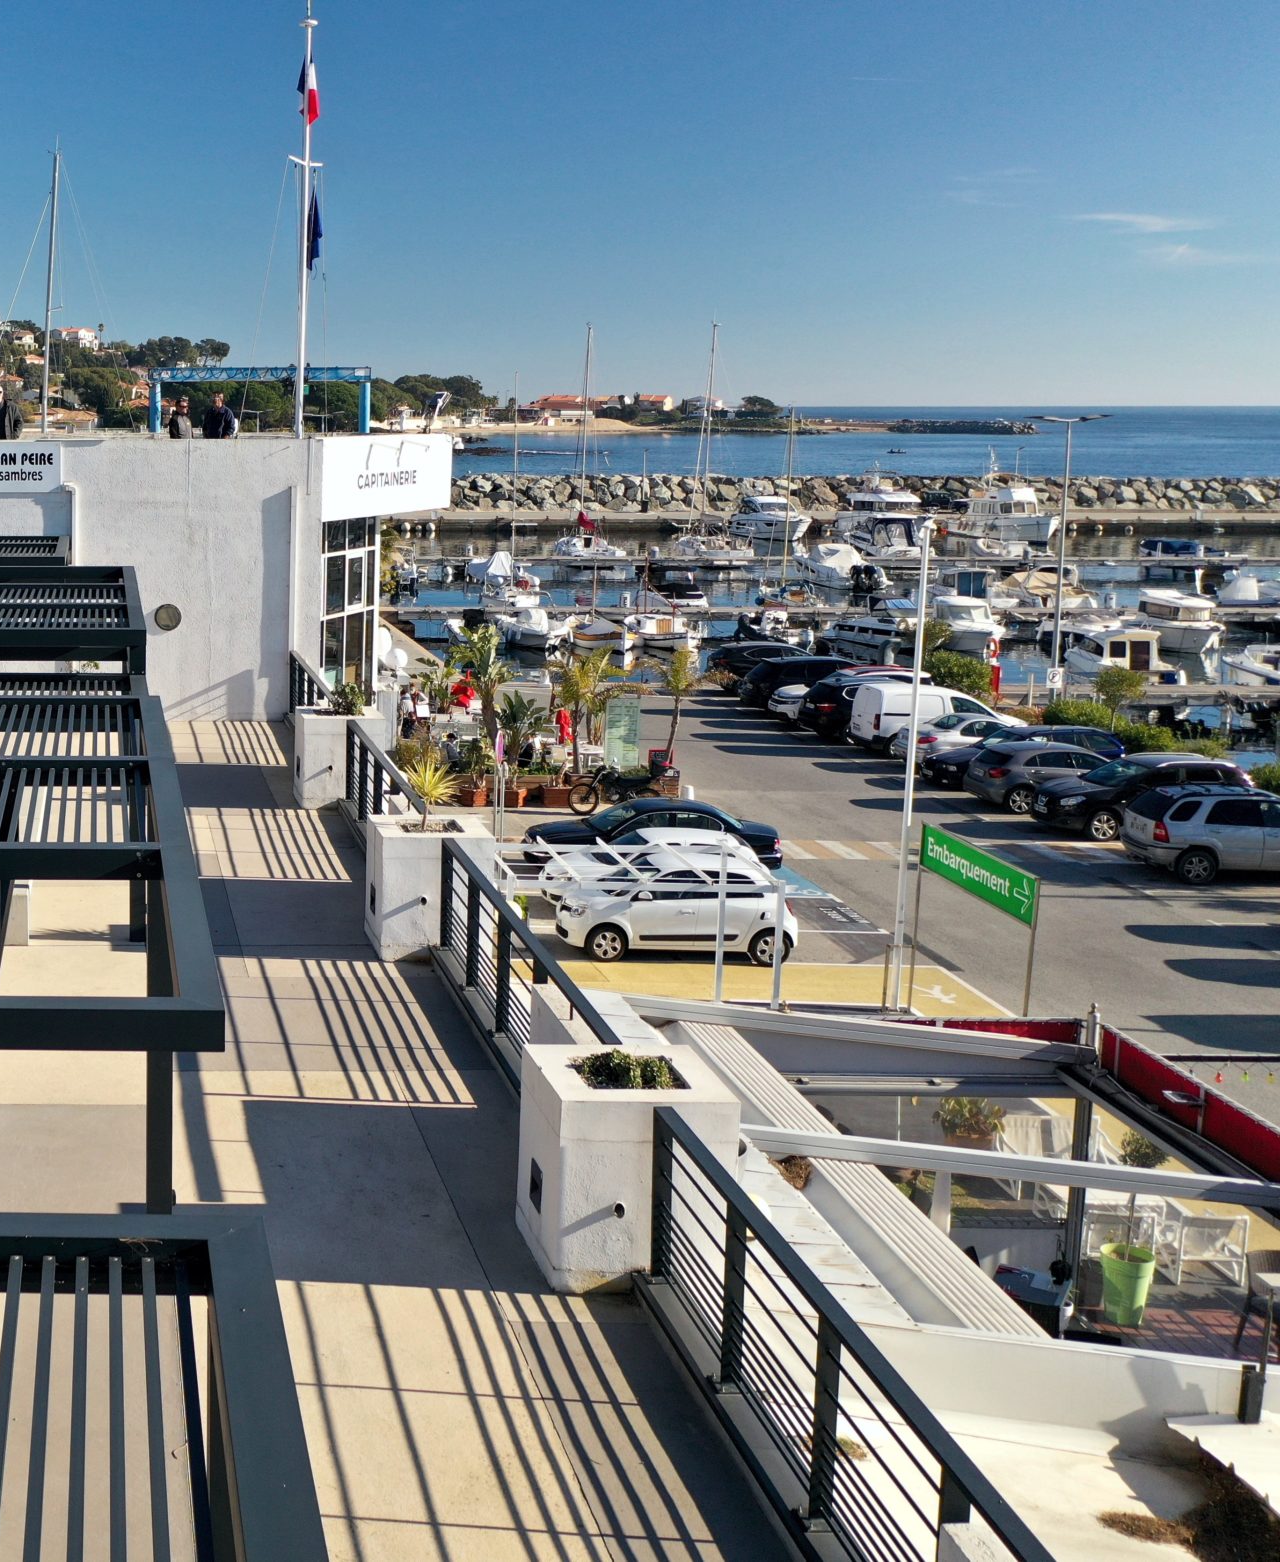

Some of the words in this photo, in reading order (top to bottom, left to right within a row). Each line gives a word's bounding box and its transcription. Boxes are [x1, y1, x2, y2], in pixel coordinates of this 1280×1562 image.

[21, 452, 54, 466] PEIRE
[357, 470, 417, 490] CAPITAINERIE
[927, 836, 1010, 897] Embarquement
